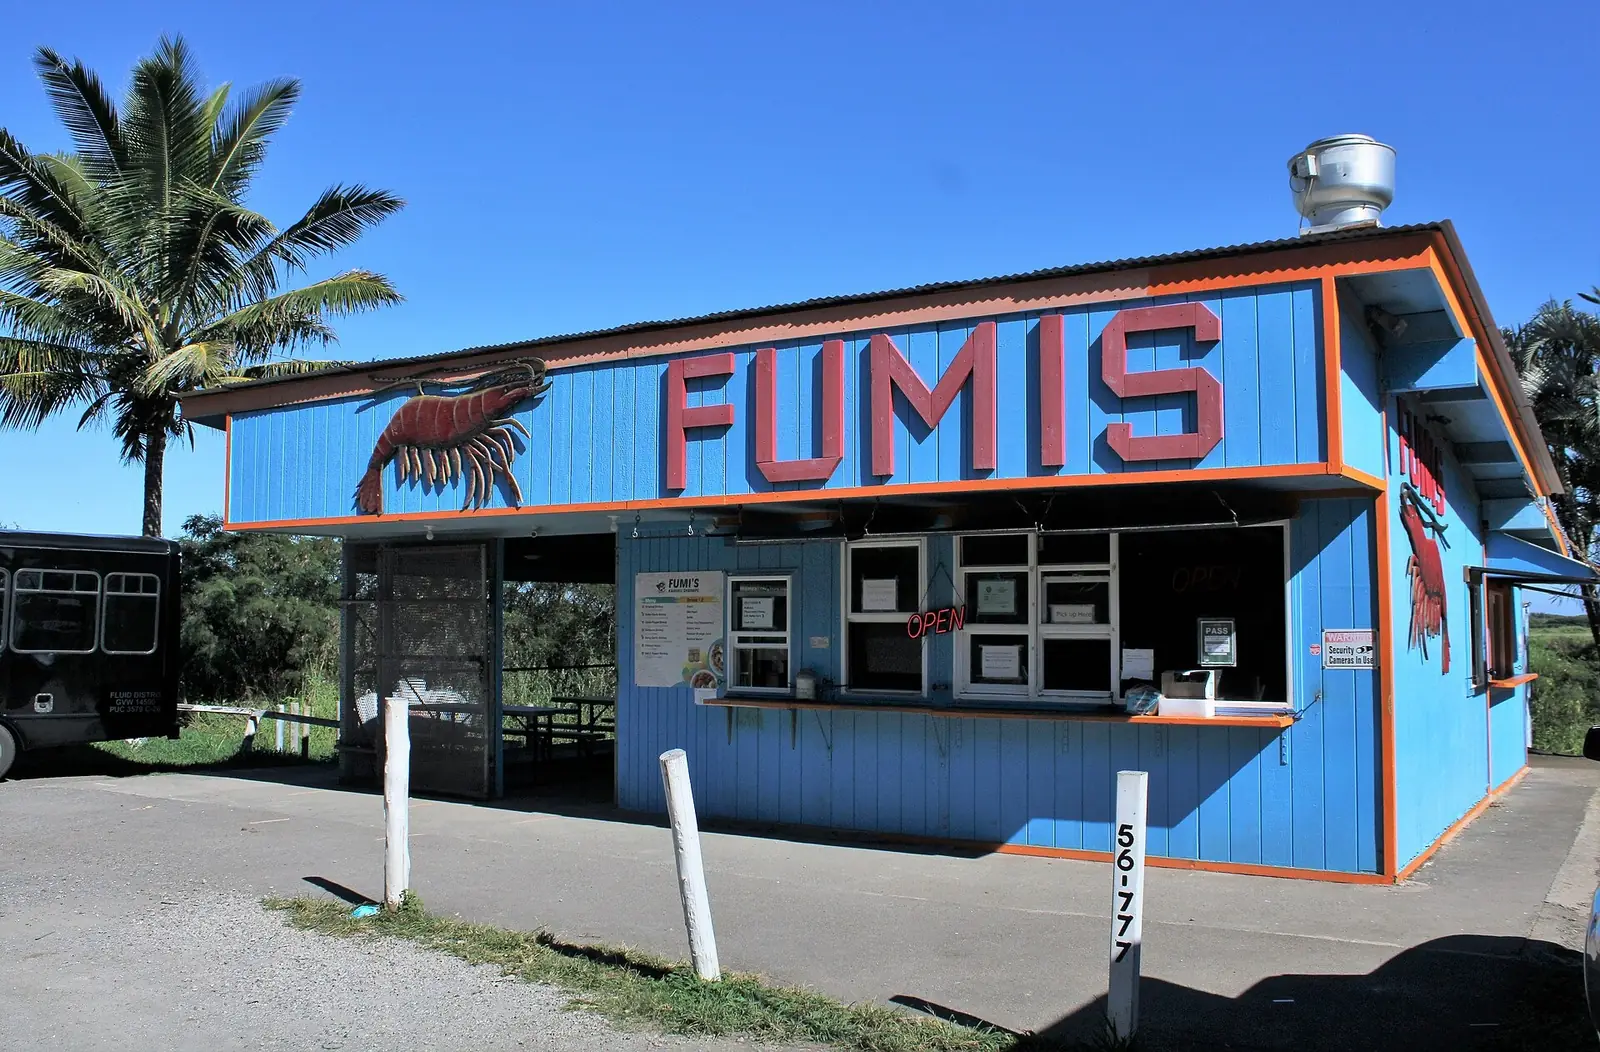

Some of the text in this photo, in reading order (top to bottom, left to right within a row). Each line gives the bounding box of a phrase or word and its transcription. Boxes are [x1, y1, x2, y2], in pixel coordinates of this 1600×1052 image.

[666, 301, 1223, 490] FUMIS
[668, 578, 700, 588] FUMI'S
[907, 604, 966, 639] OPEN
[1205, 627, 1229, 635] PASS
[1329, 645, 1354, 655] Security
[1329, 655, 1374, 664] Cameras In Use
[1115, 824, 1135, 963] 56-777
